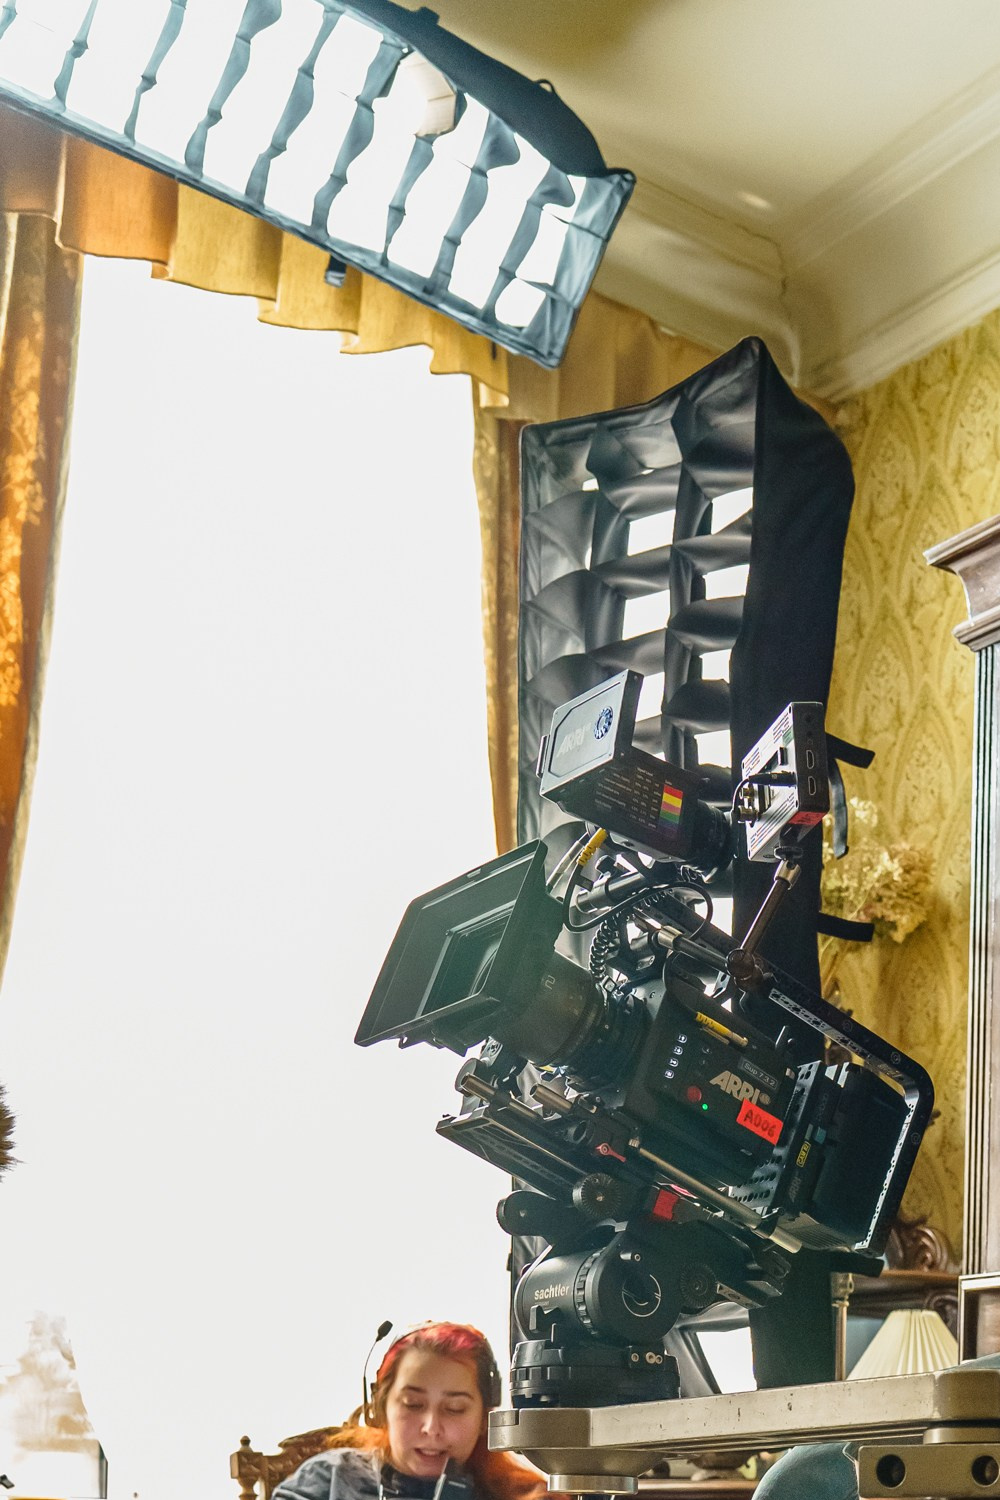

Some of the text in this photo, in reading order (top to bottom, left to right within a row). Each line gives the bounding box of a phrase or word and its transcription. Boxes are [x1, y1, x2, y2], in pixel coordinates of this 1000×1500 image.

[709, 1070, 761, 1106] ARRI
[743, 1109, 777, 1138] A006
[534, 1283, 570, 1300] sachtler
